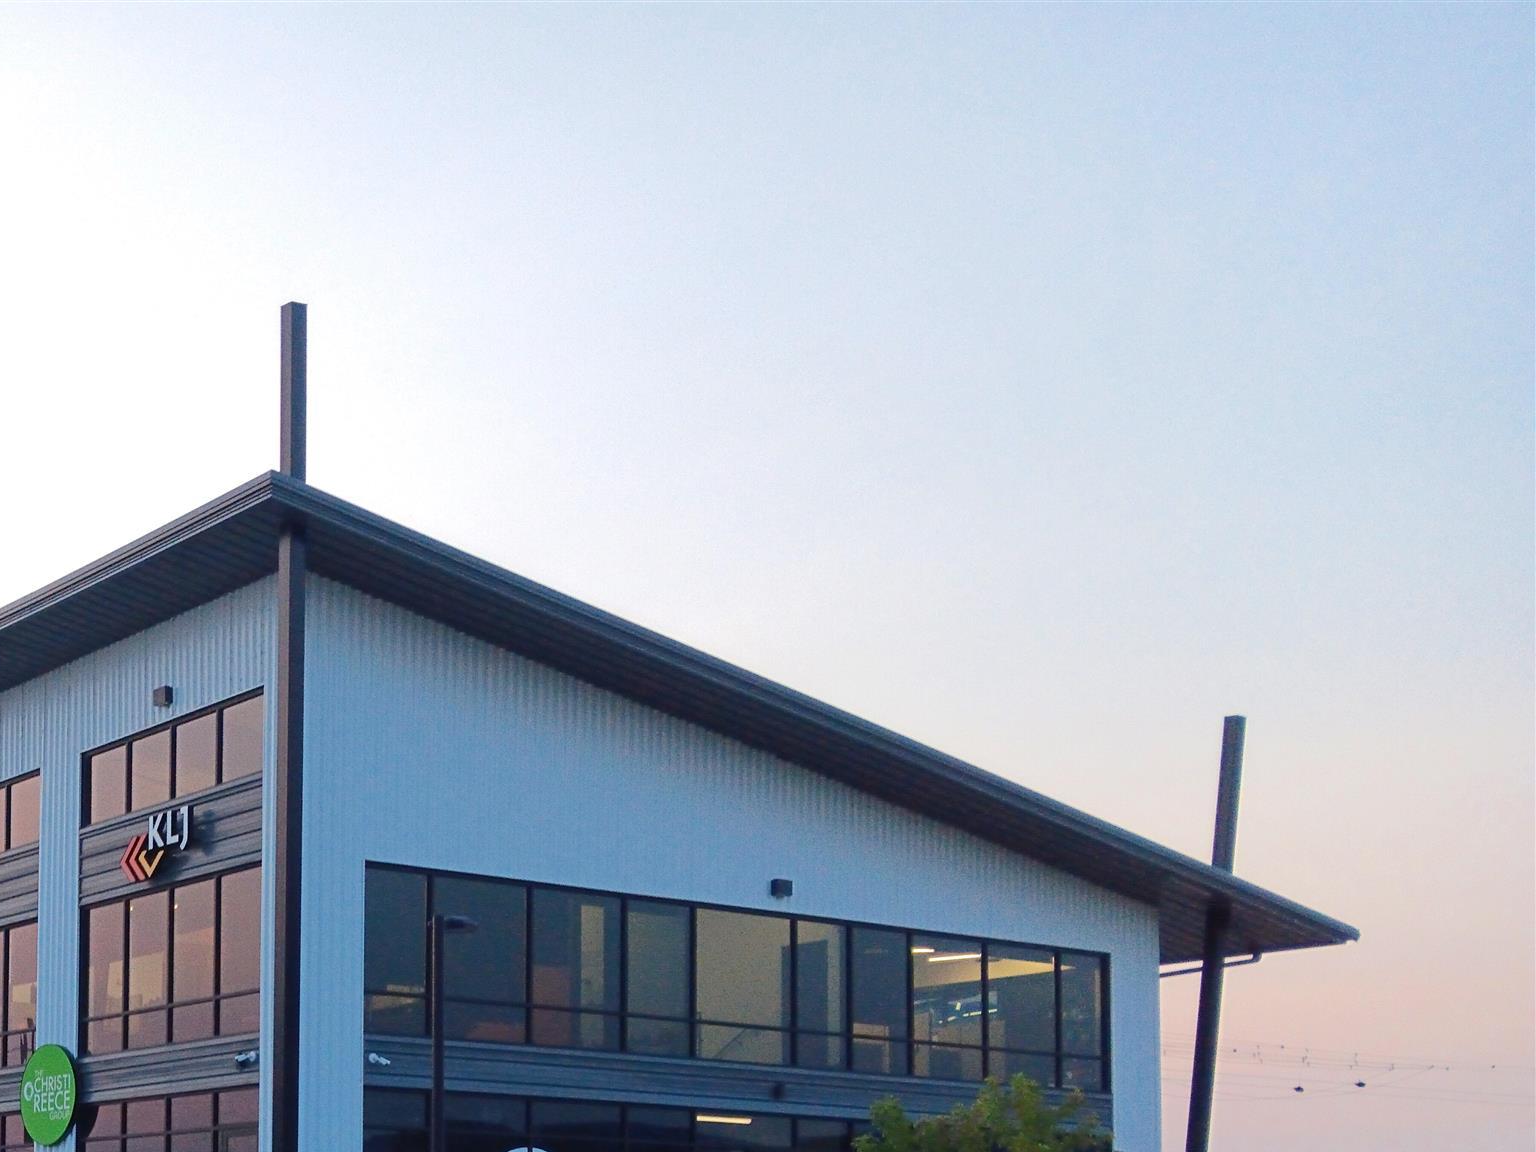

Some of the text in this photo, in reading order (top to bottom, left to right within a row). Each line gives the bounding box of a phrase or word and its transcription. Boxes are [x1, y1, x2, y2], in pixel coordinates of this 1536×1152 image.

[148, 805, 189, 851] KLJ
[34, 1073, 71, 1093] CHRISTI
[33, 1090, 71, 1113] REECE
